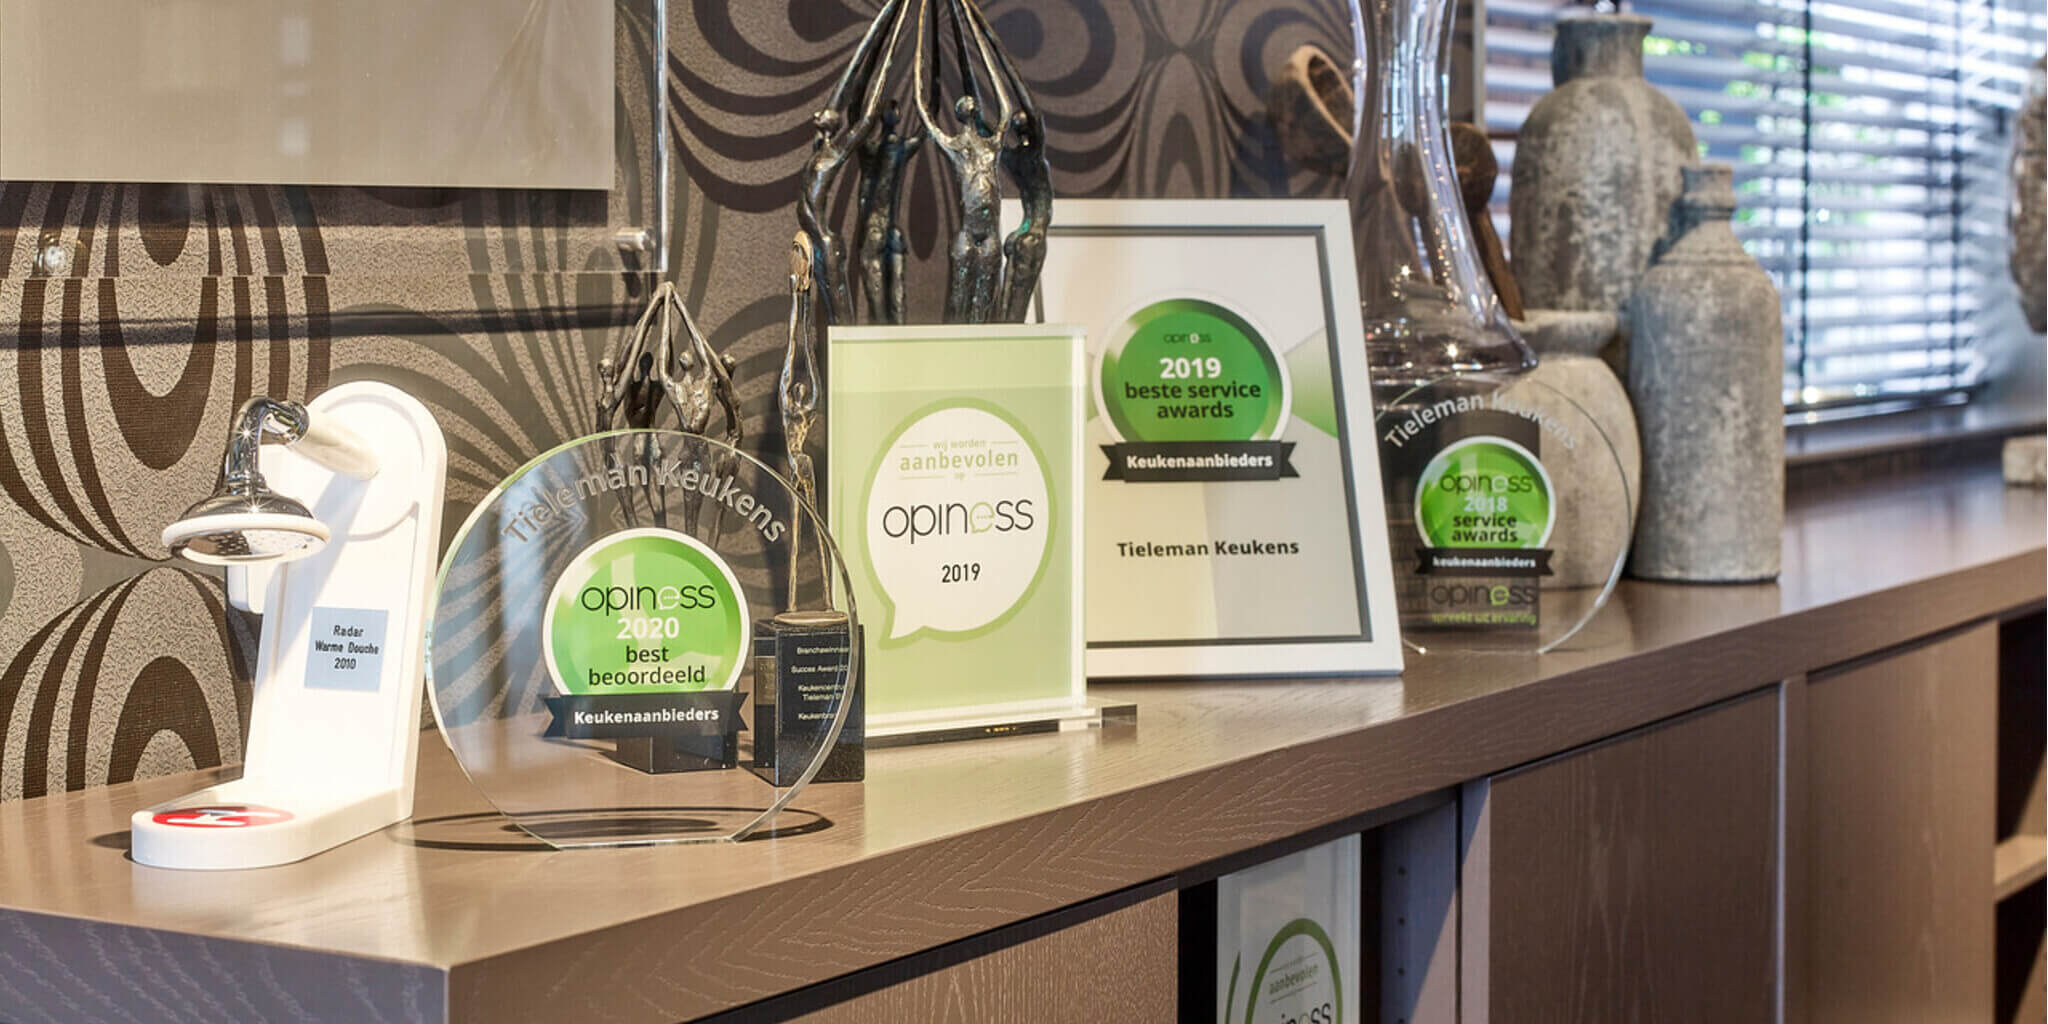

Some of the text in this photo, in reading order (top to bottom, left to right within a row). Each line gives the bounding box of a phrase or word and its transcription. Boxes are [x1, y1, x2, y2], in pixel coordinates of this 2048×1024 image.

[1159, 357, 1222, 379] 2019
[1124, 380, 1261, 399] beste service
[1157, 401, 1234, 419] awards
[1384, 394, 1484, 449] Tieleman
[900, 450, 1019, 472] aanbevolen
[1126, 453, 1273, 469] Keukenaanbieders
[1439, 473, 1533, 495] opiness
[502, 459, 787, 545] Tieleman Keukens
[1463, 496, 1508, 513] 2018
[882, 499, 1034, 545] opiness
[1452, 513, 1517, 528] service
[1451, 528, 1518, 543] awards
[1117, 539, 1300, 557] Tieleman Keukens
[941, 562, 981, 583] 2019
[581, 584, 716, 616] opiness
[1431, 585, 1537, 607] opiness
[333, 624, 364, 638] Radar
[616, 616, 680, 640] 2020
[315, 640, 379, 655] Warme Douche
[625, 643, 669, 664] best
[334, 657, 357, 670] 2010
[588, 665, 706, 687] beoordeeld
[574, 707, 720, 725] Keukenaanbieders
